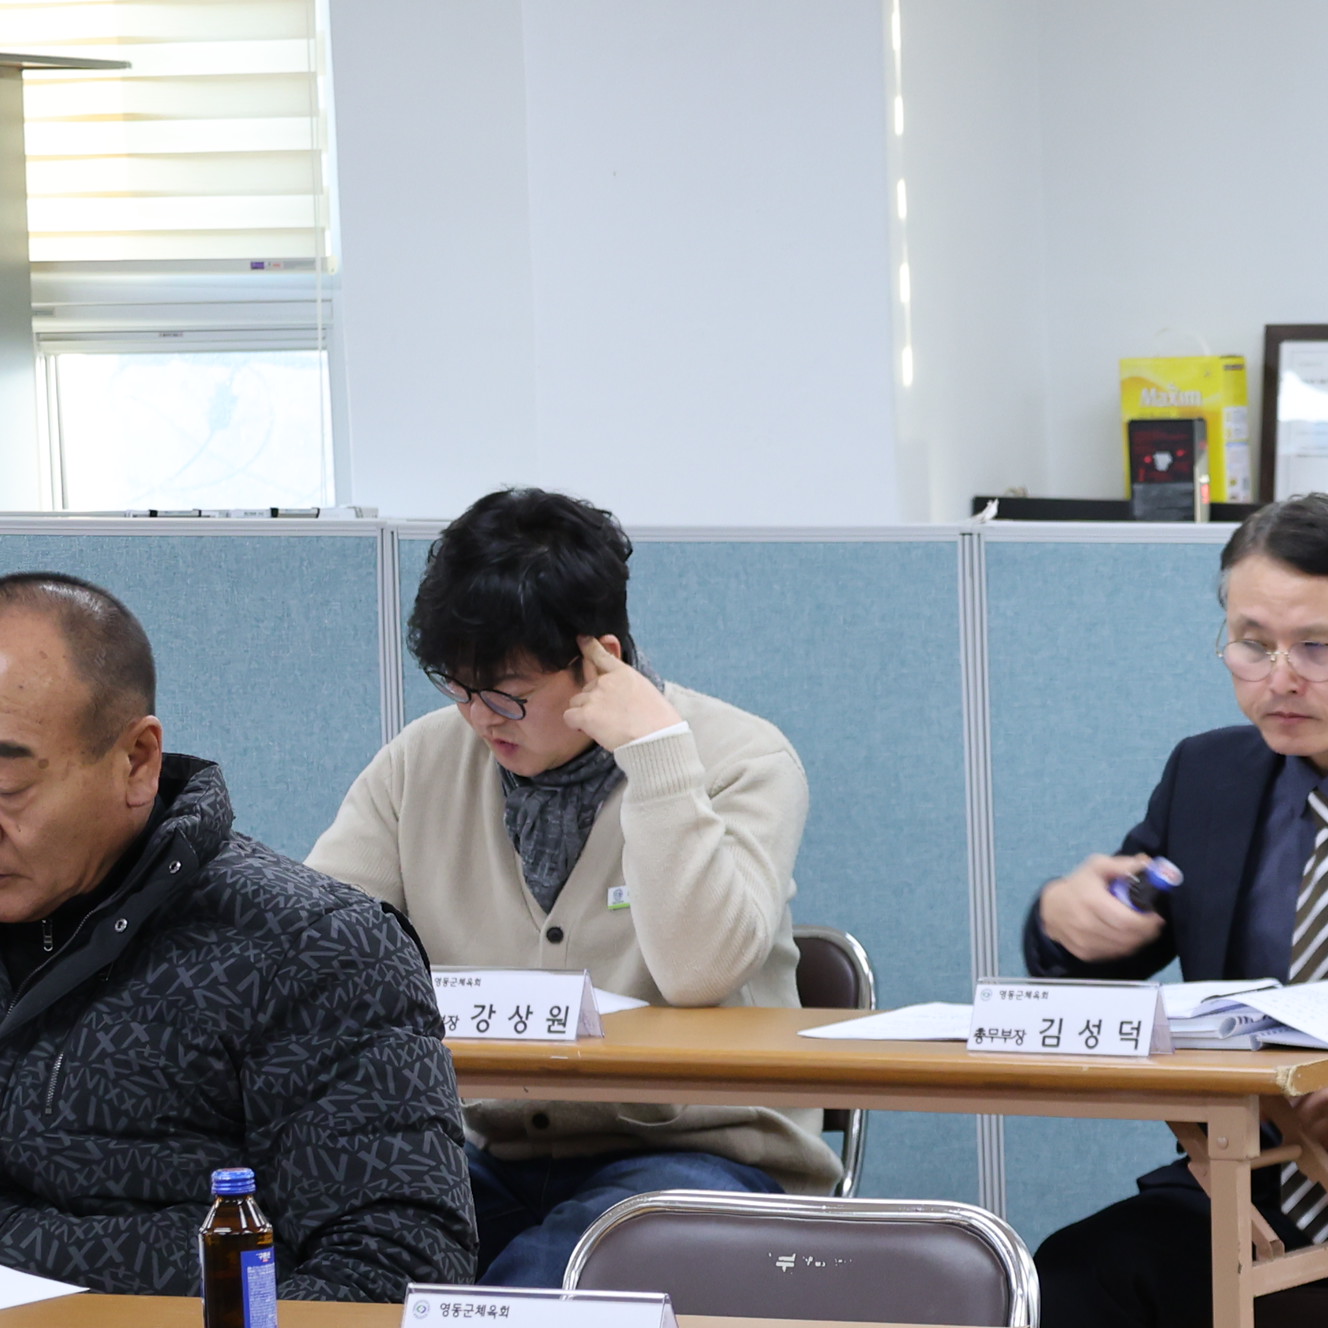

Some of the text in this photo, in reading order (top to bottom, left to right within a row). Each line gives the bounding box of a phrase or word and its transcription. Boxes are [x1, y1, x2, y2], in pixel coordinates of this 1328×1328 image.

[441, 1014, 460, 1031] 장
[1039, 1018, 1142, 1050] 김성덕
[439, 1302, 510, 1319] 영동군체육회
